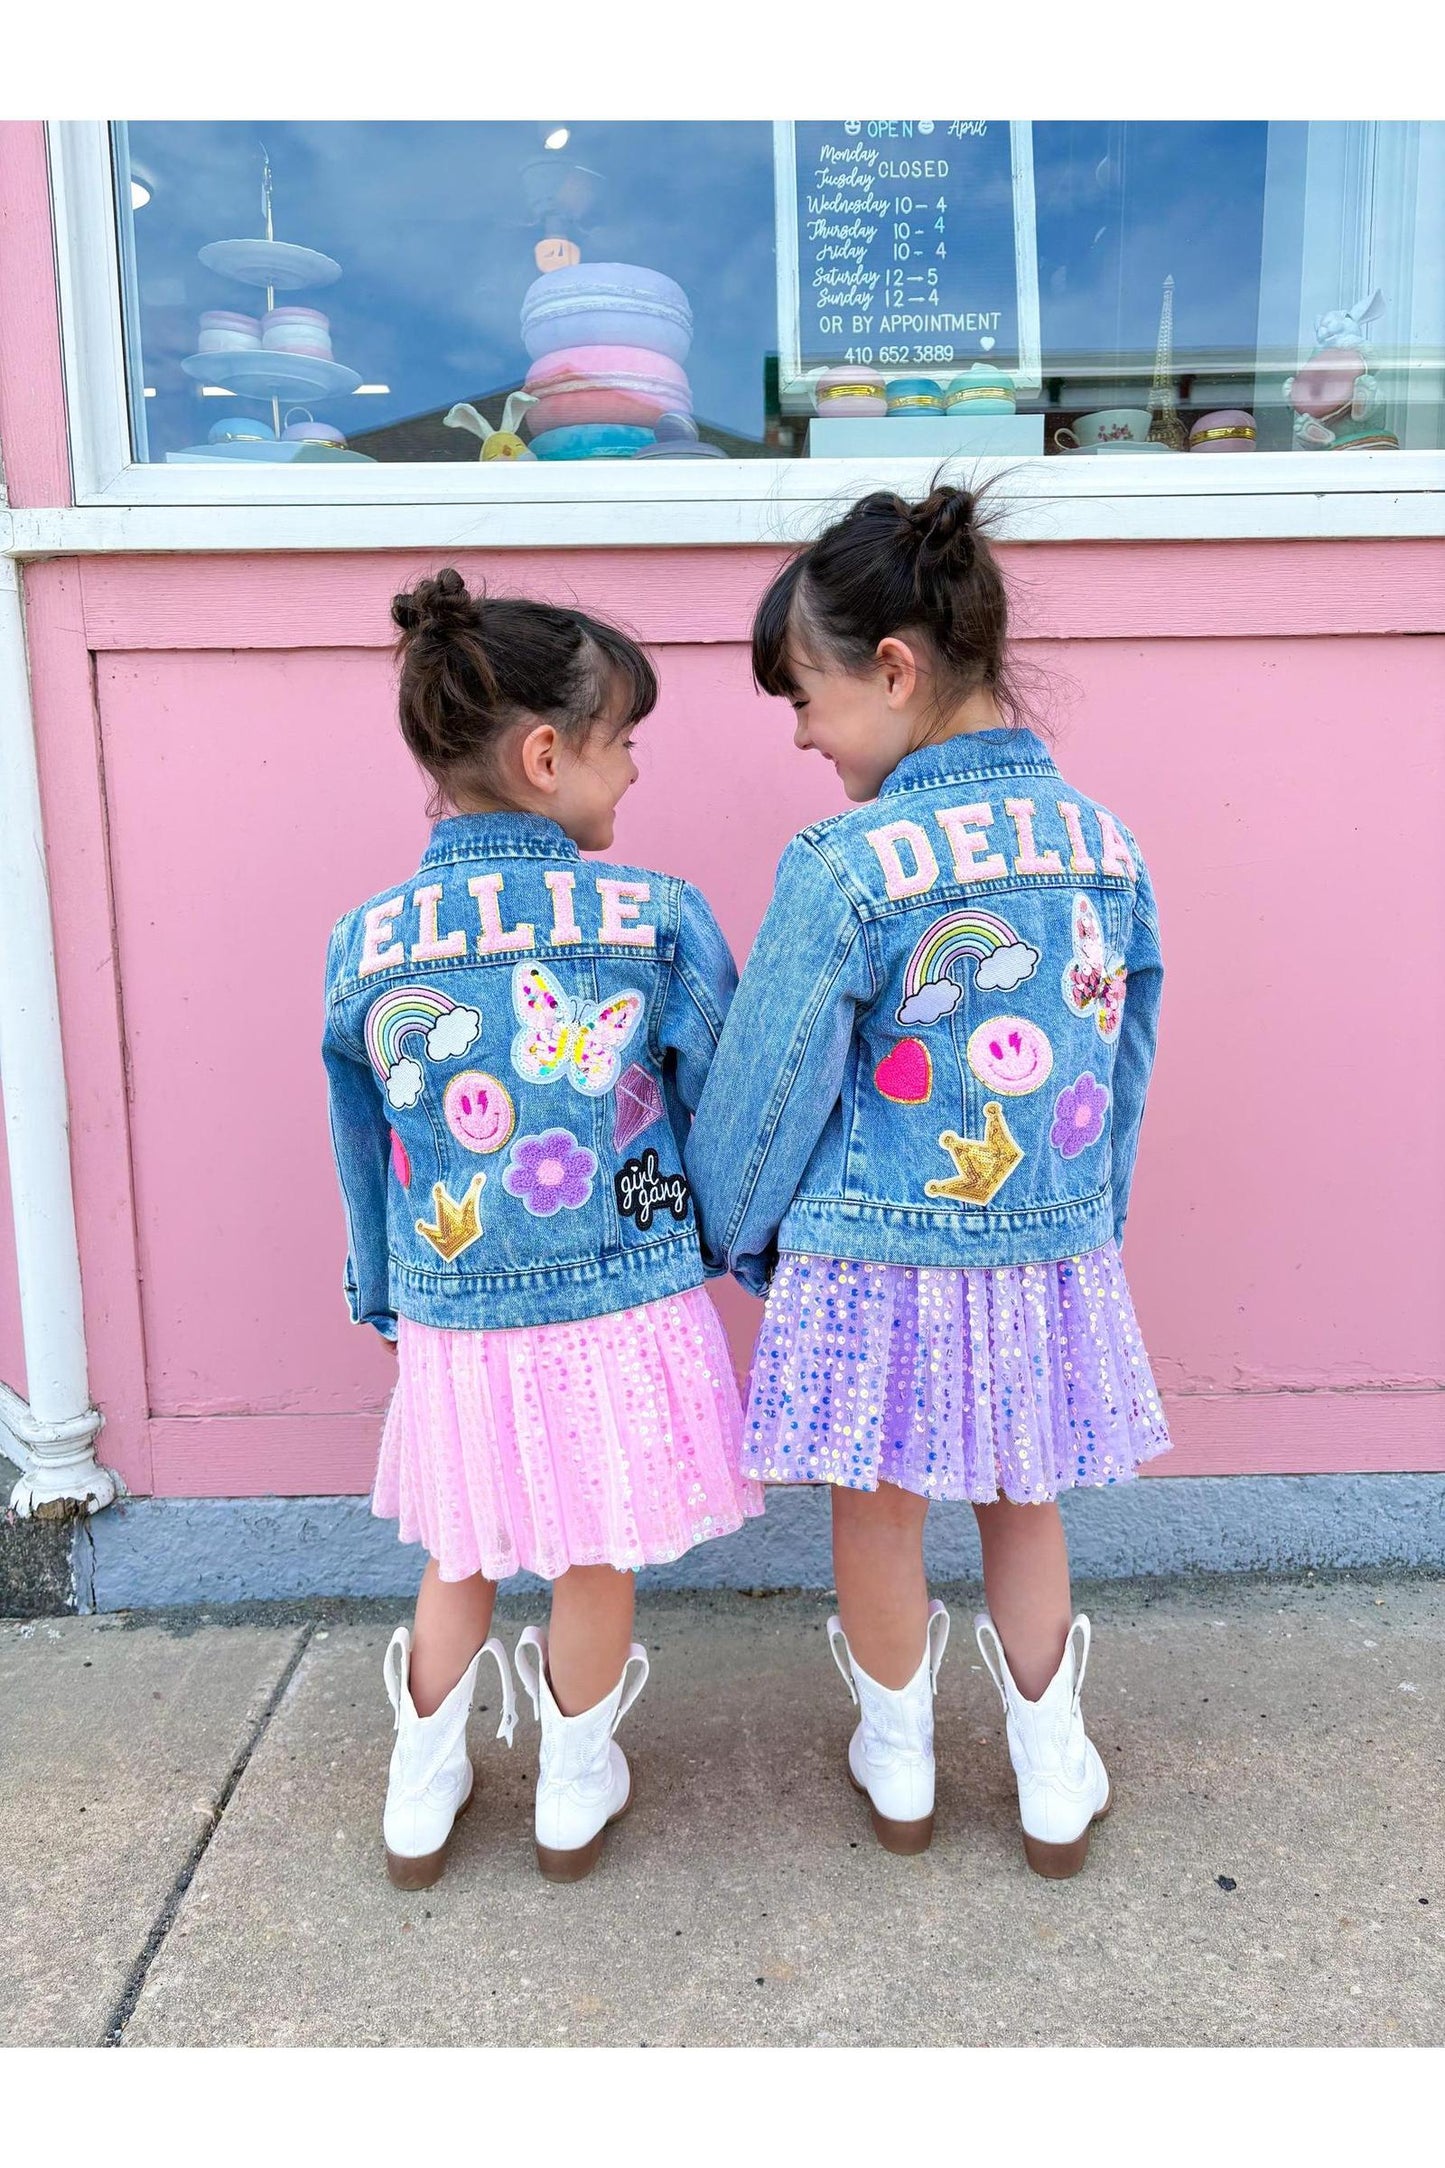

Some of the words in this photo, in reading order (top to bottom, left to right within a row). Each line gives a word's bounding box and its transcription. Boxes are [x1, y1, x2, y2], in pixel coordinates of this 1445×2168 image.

[867, 120, 913, 138] OPEN
[820, 142, 879, 167] Monday
[815, 167, 875, 193] Tuesday
[878, 160, 949, 178] CLOSED
[806, 192, 891, 218] Wednesday
[807, 218, 878, 243] Thursday
[816, 238, 868, 266] Friday
[812, 264, 881, 290] Saturday
[816, 285, 874, 311] Sunday
[819, 315, 843, 334] OR
[852, 315, 874, 334] BY
[879, 312, 1002, 334] APPOINTMENT
[844, 347, 873, 364] 410
[879, 346, 909, 364] 652
[912, 345, 954, 363] 3889
[865, 799, 1137, 902] DELIA
[357, 870, 658, 979] ELLIE
[620, 1154, 660, 1210] girl
[638, 1180, 687, 1223] gang
